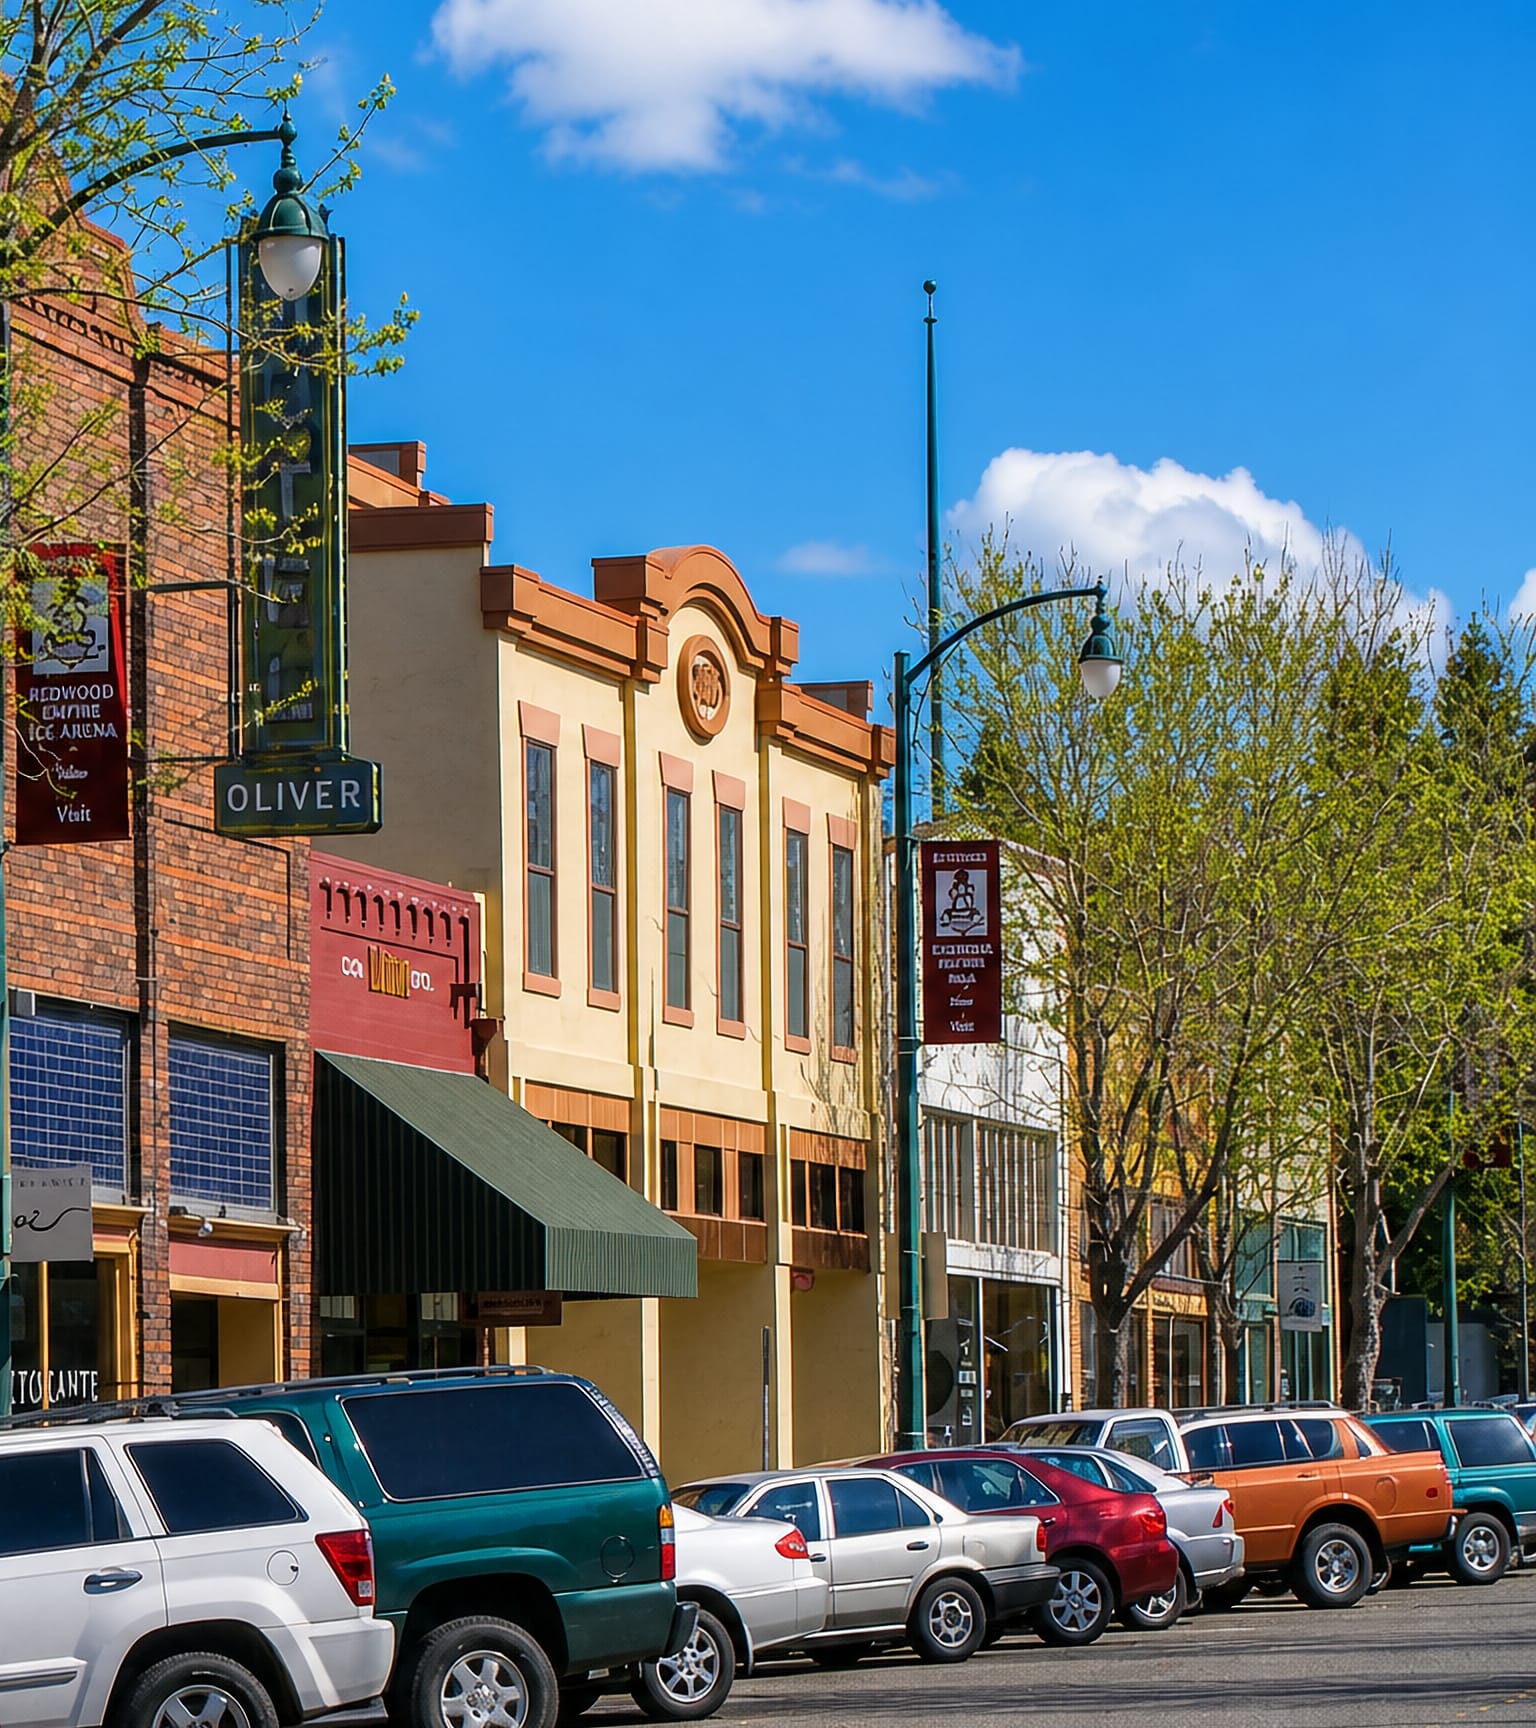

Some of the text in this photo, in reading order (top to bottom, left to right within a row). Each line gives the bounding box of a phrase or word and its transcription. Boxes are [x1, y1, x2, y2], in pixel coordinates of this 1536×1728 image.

[29, 684, 114, 702] REDWOOD
[28, 723, 55, 741] ICE
[227, 779, 361, 812] OLIVER
